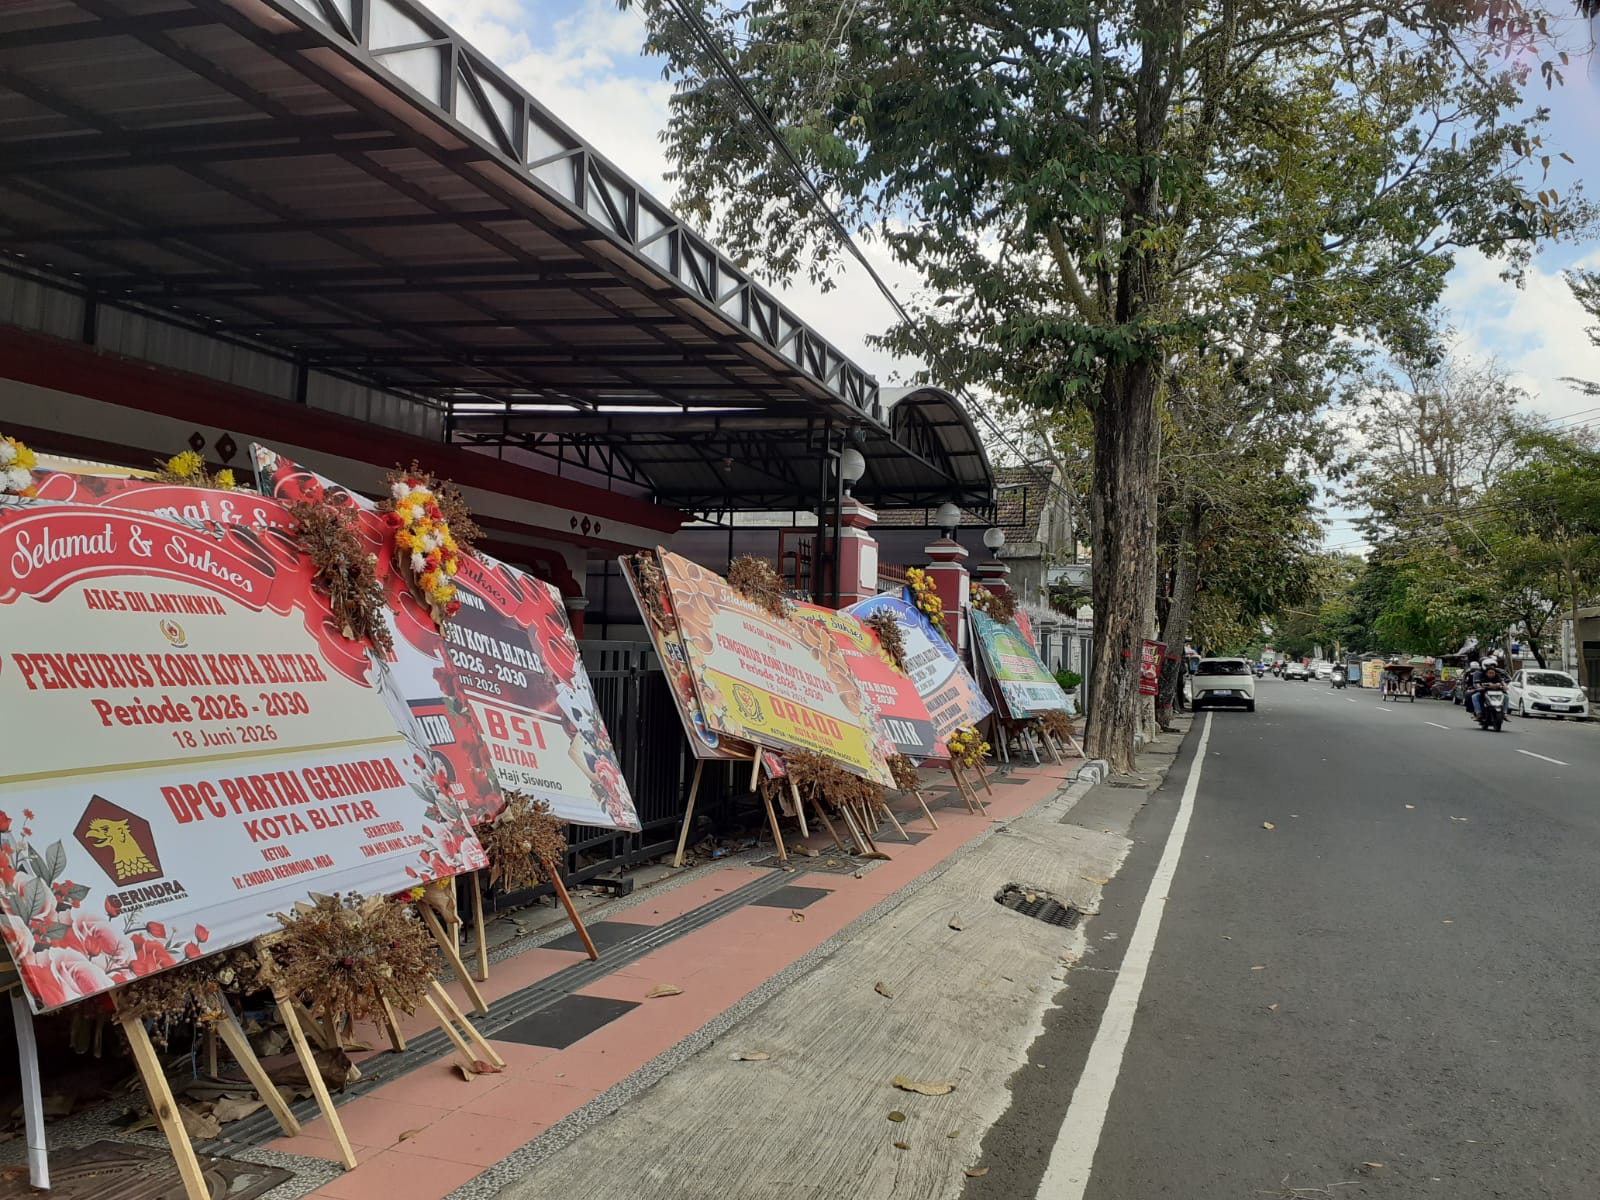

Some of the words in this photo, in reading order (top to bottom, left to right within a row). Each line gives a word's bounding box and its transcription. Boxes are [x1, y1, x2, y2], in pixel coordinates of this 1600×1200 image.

[11, 523, 117, 579] Selamat
[129, 524, 152, 557] &
[164, 535, 254, 593] Sukses
[83, 588, 128, 611] ATAS
[123, 591, 227, 616] DILANTIKNYA
[464, 627, 503, 661] KOTA
[500, 641, 545, 675] BLITAR
[11, 653, 154, 690] PENGURUS
[146, 653, 212, 687] KONI
[202, 653, 267, 686] KOTA
[256, 653, 328, 684] BLITAR
[450, 648, 486, 674] 2026
[494, 663, 528, 689] 2030
[474, 676, 502, 695] 2026
[91, 695, 193, 727] Periode
[191, 694, 248, 721] 2026
[259, 691, 310, 717] 2030
[172, 729, 198, 749] 18
[200, 726, 237, 747] Juni
[237, 724, 278, 744] 2026
[492, 743, 538, 769] BLITAR
[160, 781, 227, 824] DPC
[218, 770, 311, 814] PARTAI
[302, 757, 406, 801] GERINDRA
[521, 772, 563, 791] Siswono
[243, 813, 309, 843] KOTA
[306, 800, 381, 830] BLITAR
[363, 821, 405, 839] SEKRETARIS
[261, 845, 292, 862] KETUA
[242, 868, 275, 888] ENDRO
[313, 854, 335, 869] MBA
[107, 880, 186, 909] GERINDRA
